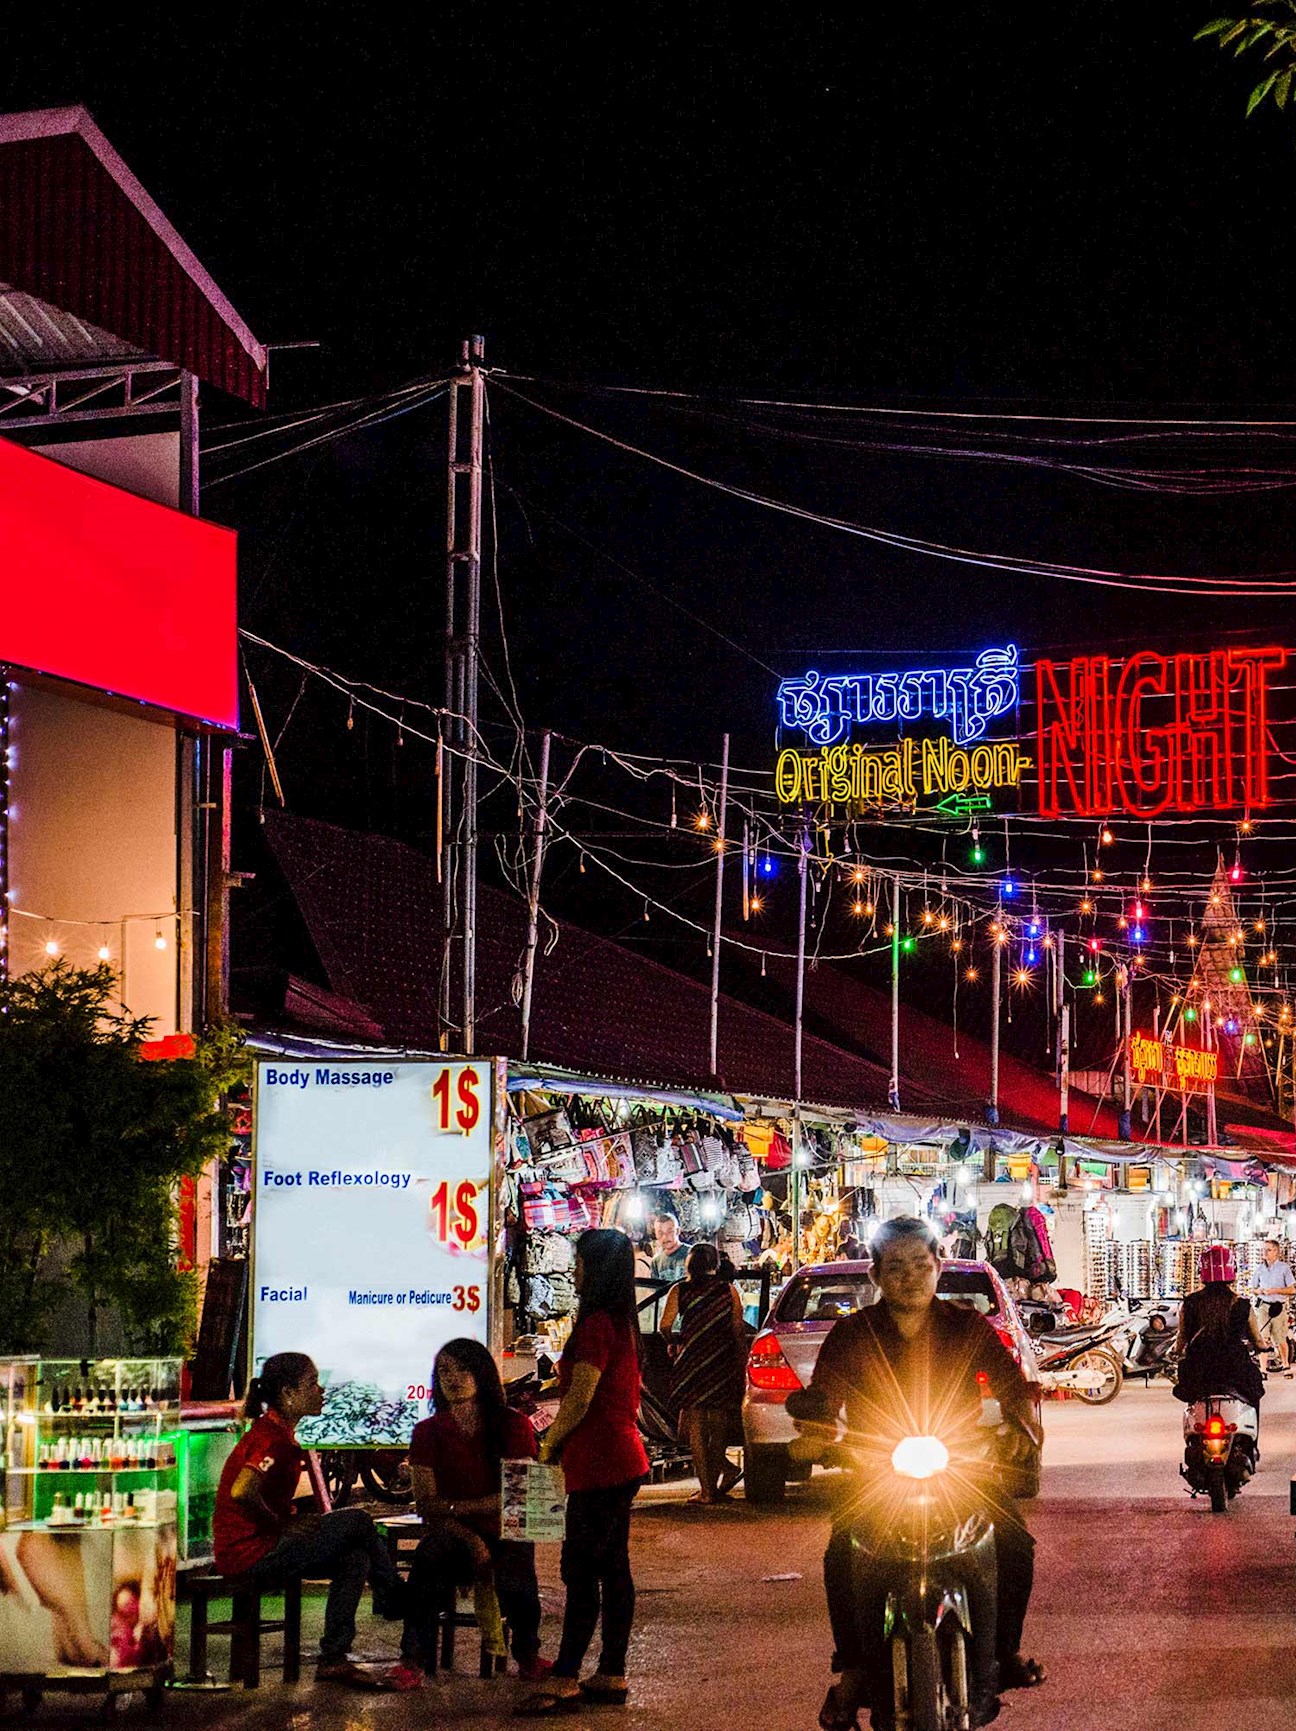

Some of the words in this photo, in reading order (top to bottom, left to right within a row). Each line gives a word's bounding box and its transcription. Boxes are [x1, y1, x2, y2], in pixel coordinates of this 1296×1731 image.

[1036, 647, 1286, 817] NIGHT
[776, 738, 916, 802] Original
[266, 1069, 309, 1088] Body
[315, 1069, 394, 1087] Massage
[432, 1065, 480, 1136] 1$
[264, 1171, 302, 1185] Foot
[308, 1171, 411, 1188] Reflexology
[431, 1178, 478, 1249] 1$
[261, 1286, 307, 1301] Facial
[349, 1290, 393, 1304] Manicure
[396, 1294, 406, 1304] or
[409, 1290, 451, 1304] Pedicure
[452, 1285, 481, 1314] 3$
